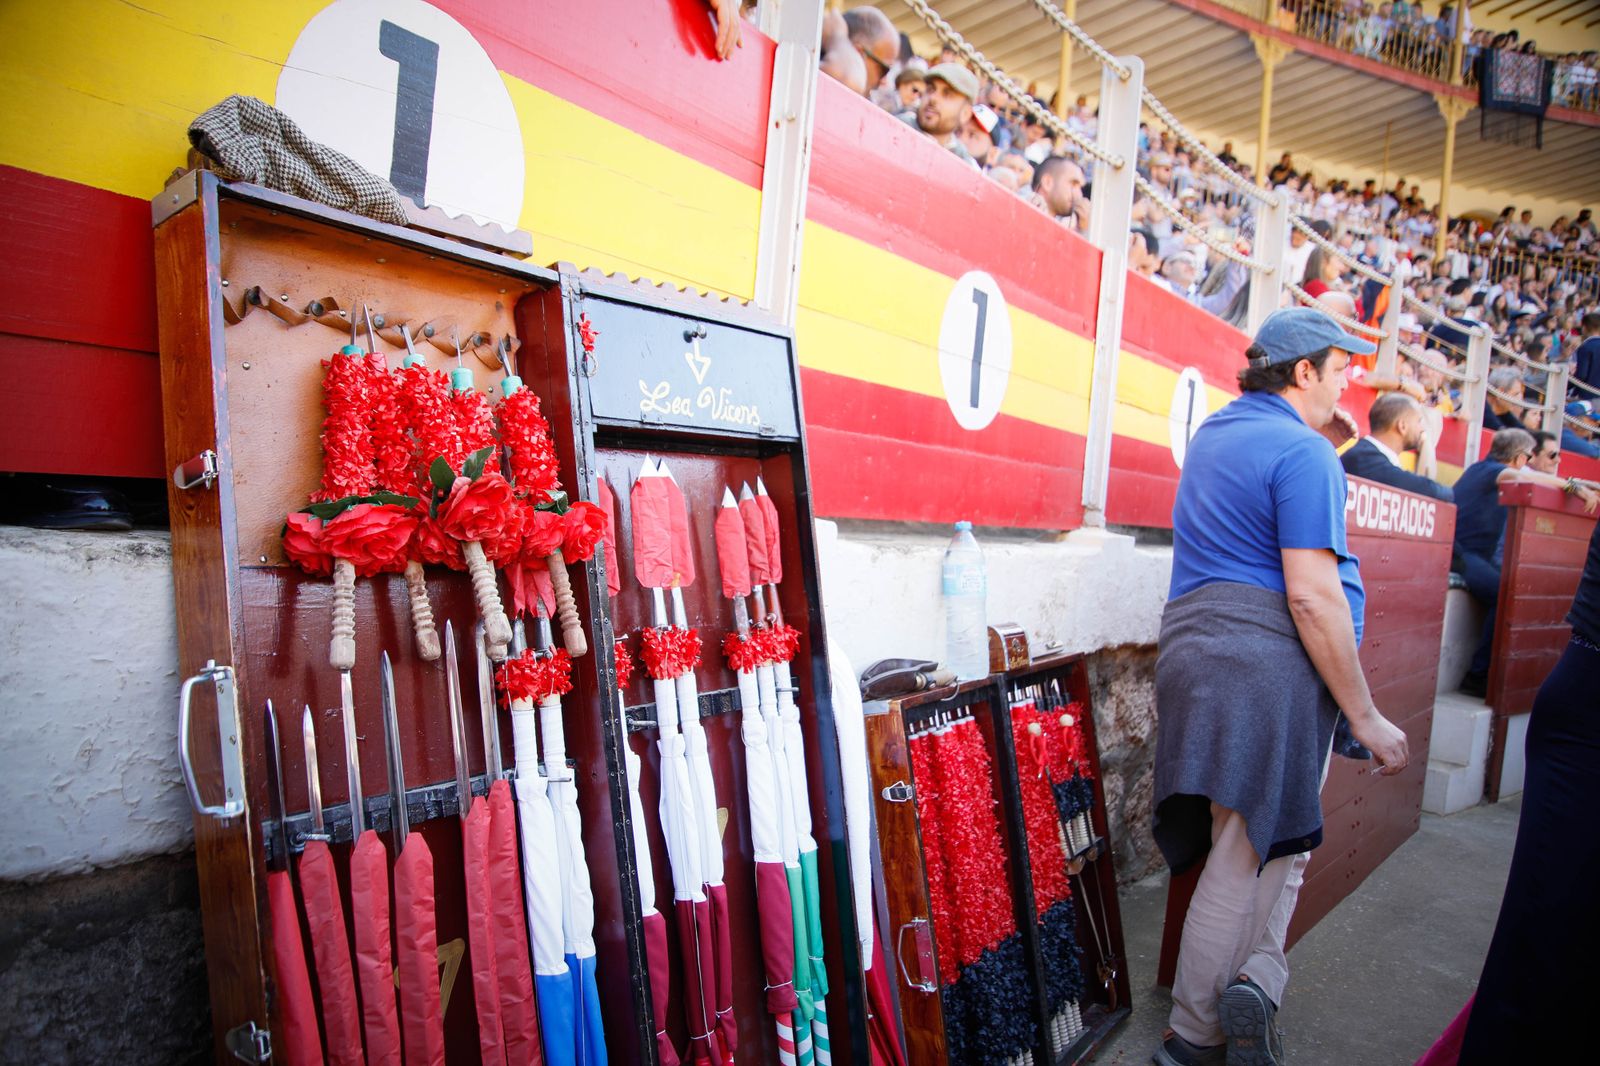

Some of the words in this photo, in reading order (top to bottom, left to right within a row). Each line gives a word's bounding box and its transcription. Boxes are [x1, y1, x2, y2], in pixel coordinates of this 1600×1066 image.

[379, 19, 440, 210] 1
[970, 287, 988, 409] 1
[639, 379, 694, 418] Lea
[697, 386, 761, 427] Vicens
[1185, 378, 1195, 449] 1
